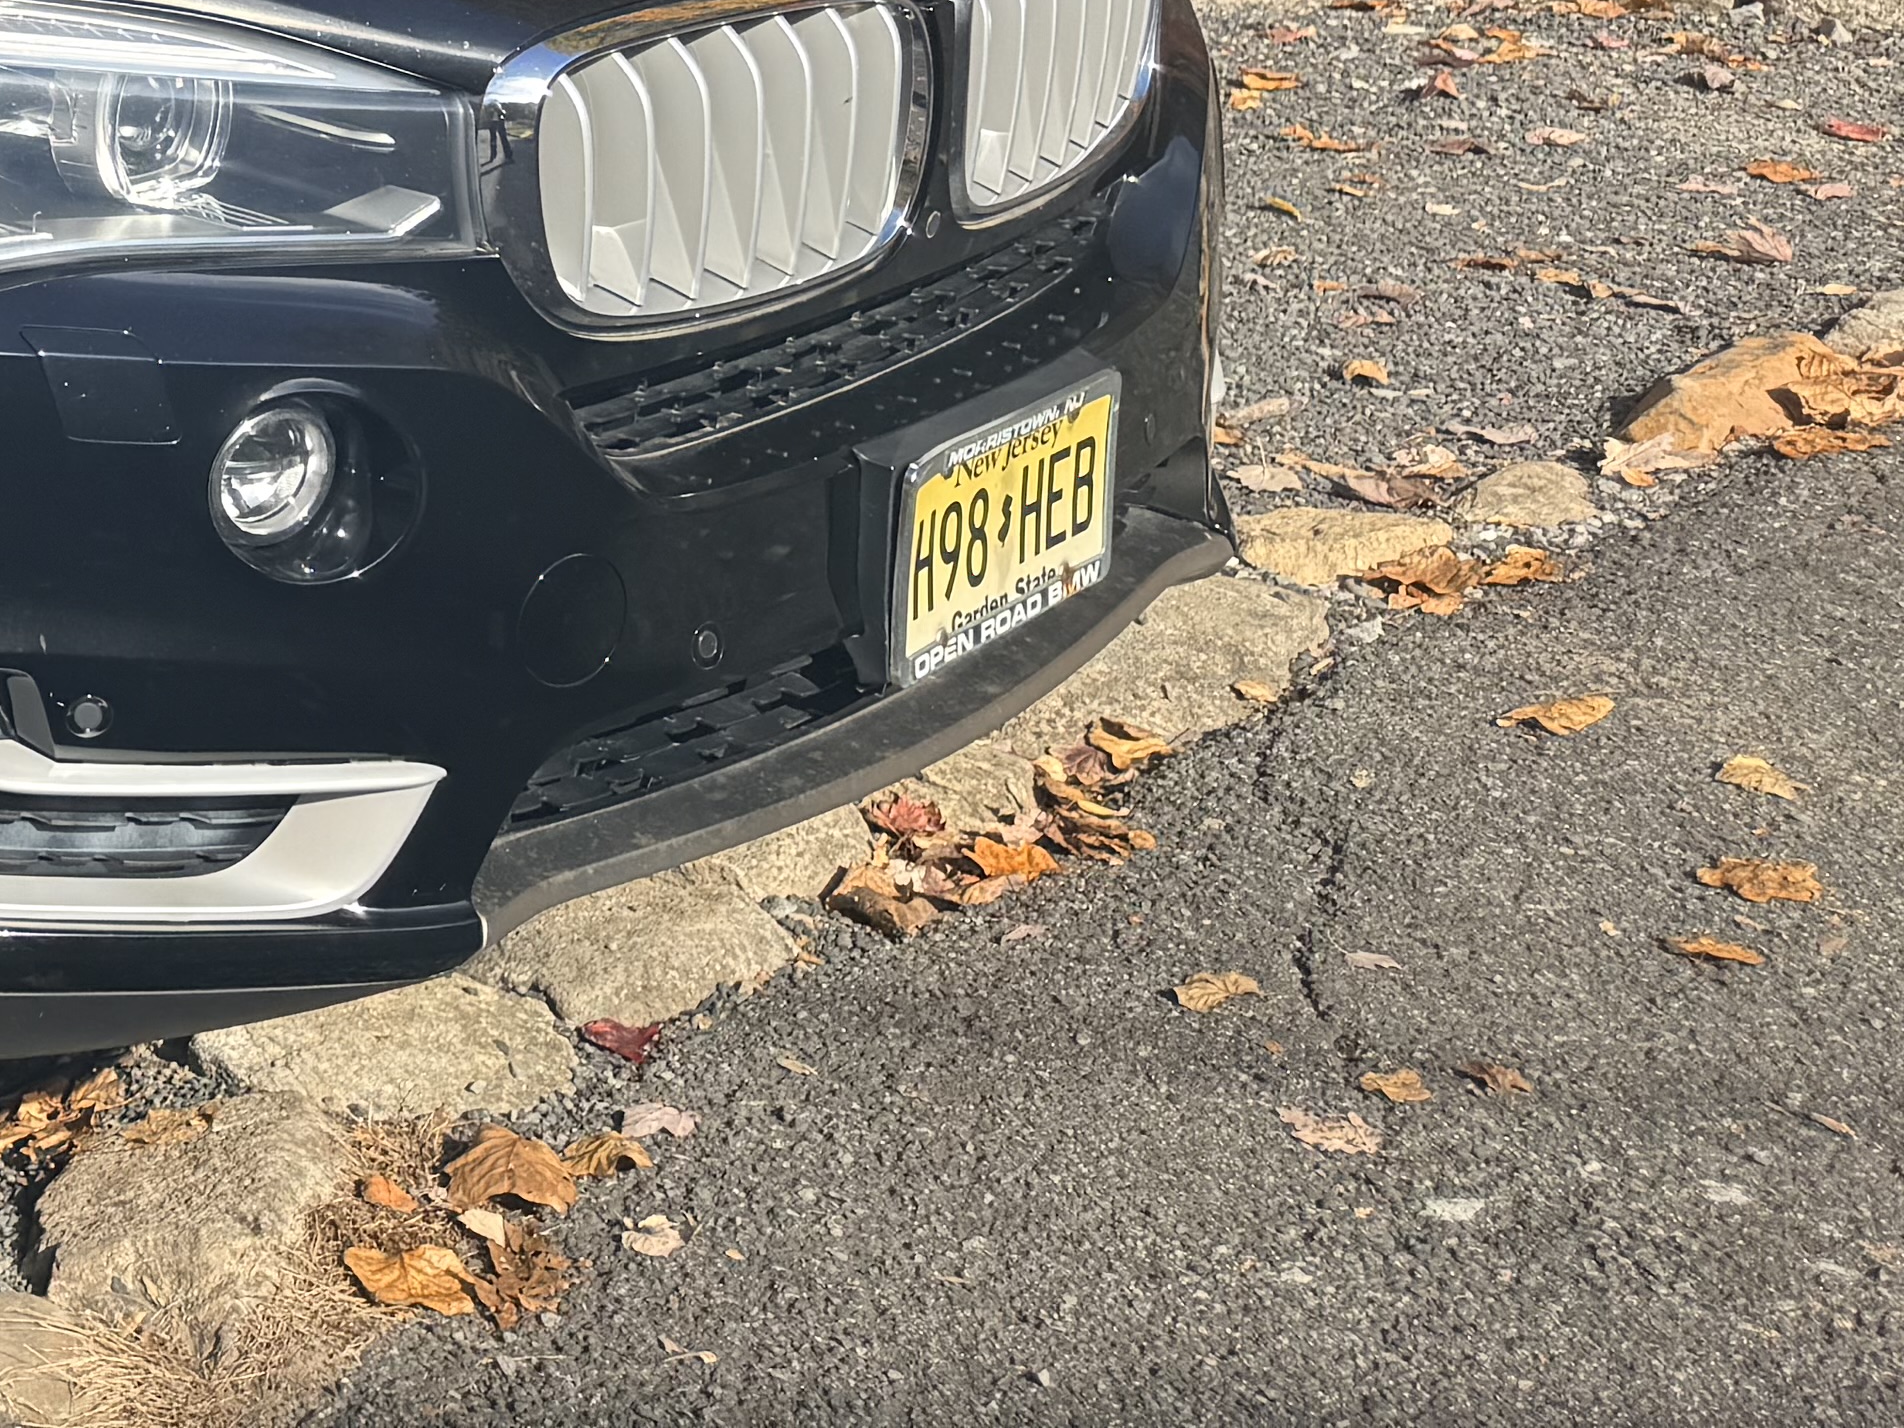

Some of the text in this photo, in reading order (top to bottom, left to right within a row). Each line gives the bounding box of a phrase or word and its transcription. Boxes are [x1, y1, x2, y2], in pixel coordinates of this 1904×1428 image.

[1064, 391, 1086, 414] NJ
[954, 419, 1063, 488] New Jersey
[914, 560, 1101, 679] OPEN ROAD BMW
[951, 566, 1056, 631] Garden State
